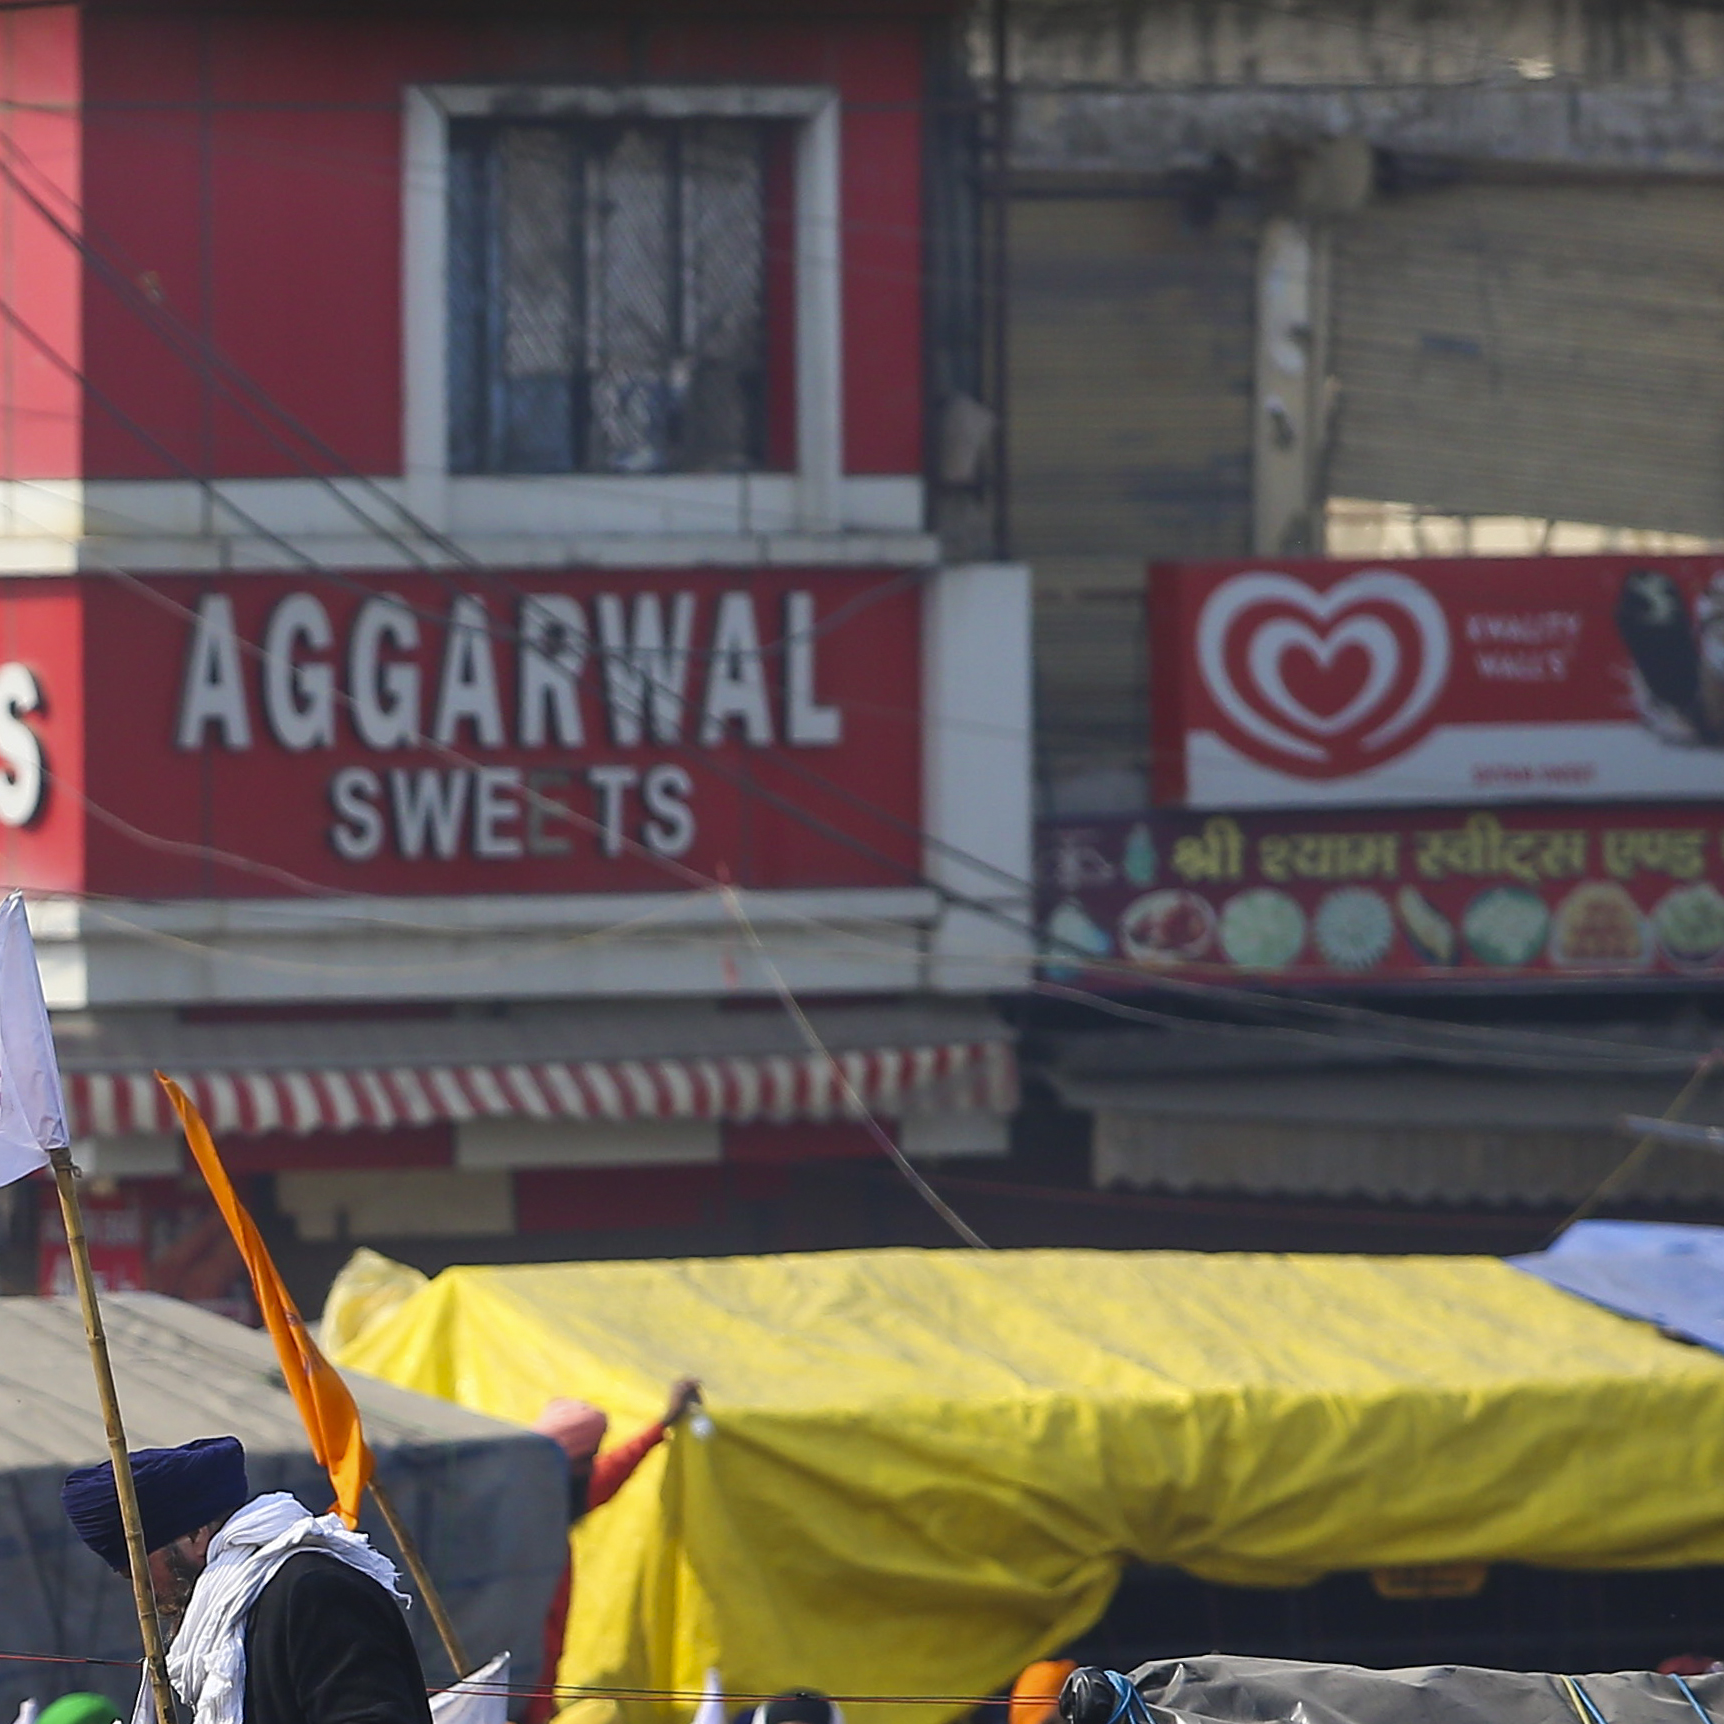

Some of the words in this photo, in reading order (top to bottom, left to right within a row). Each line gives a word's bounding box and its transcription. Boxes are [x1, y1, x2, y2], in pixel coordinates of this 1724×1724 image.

[177, 591, 844, 752] AGGARWAL
[331, 764, 698, 862] SWEETS
[1171, 813, 1245, 882] श्री
[1260, 830, 1403, 881] श्याम
[1414, 813, 1589, 883] स्वीट्स
